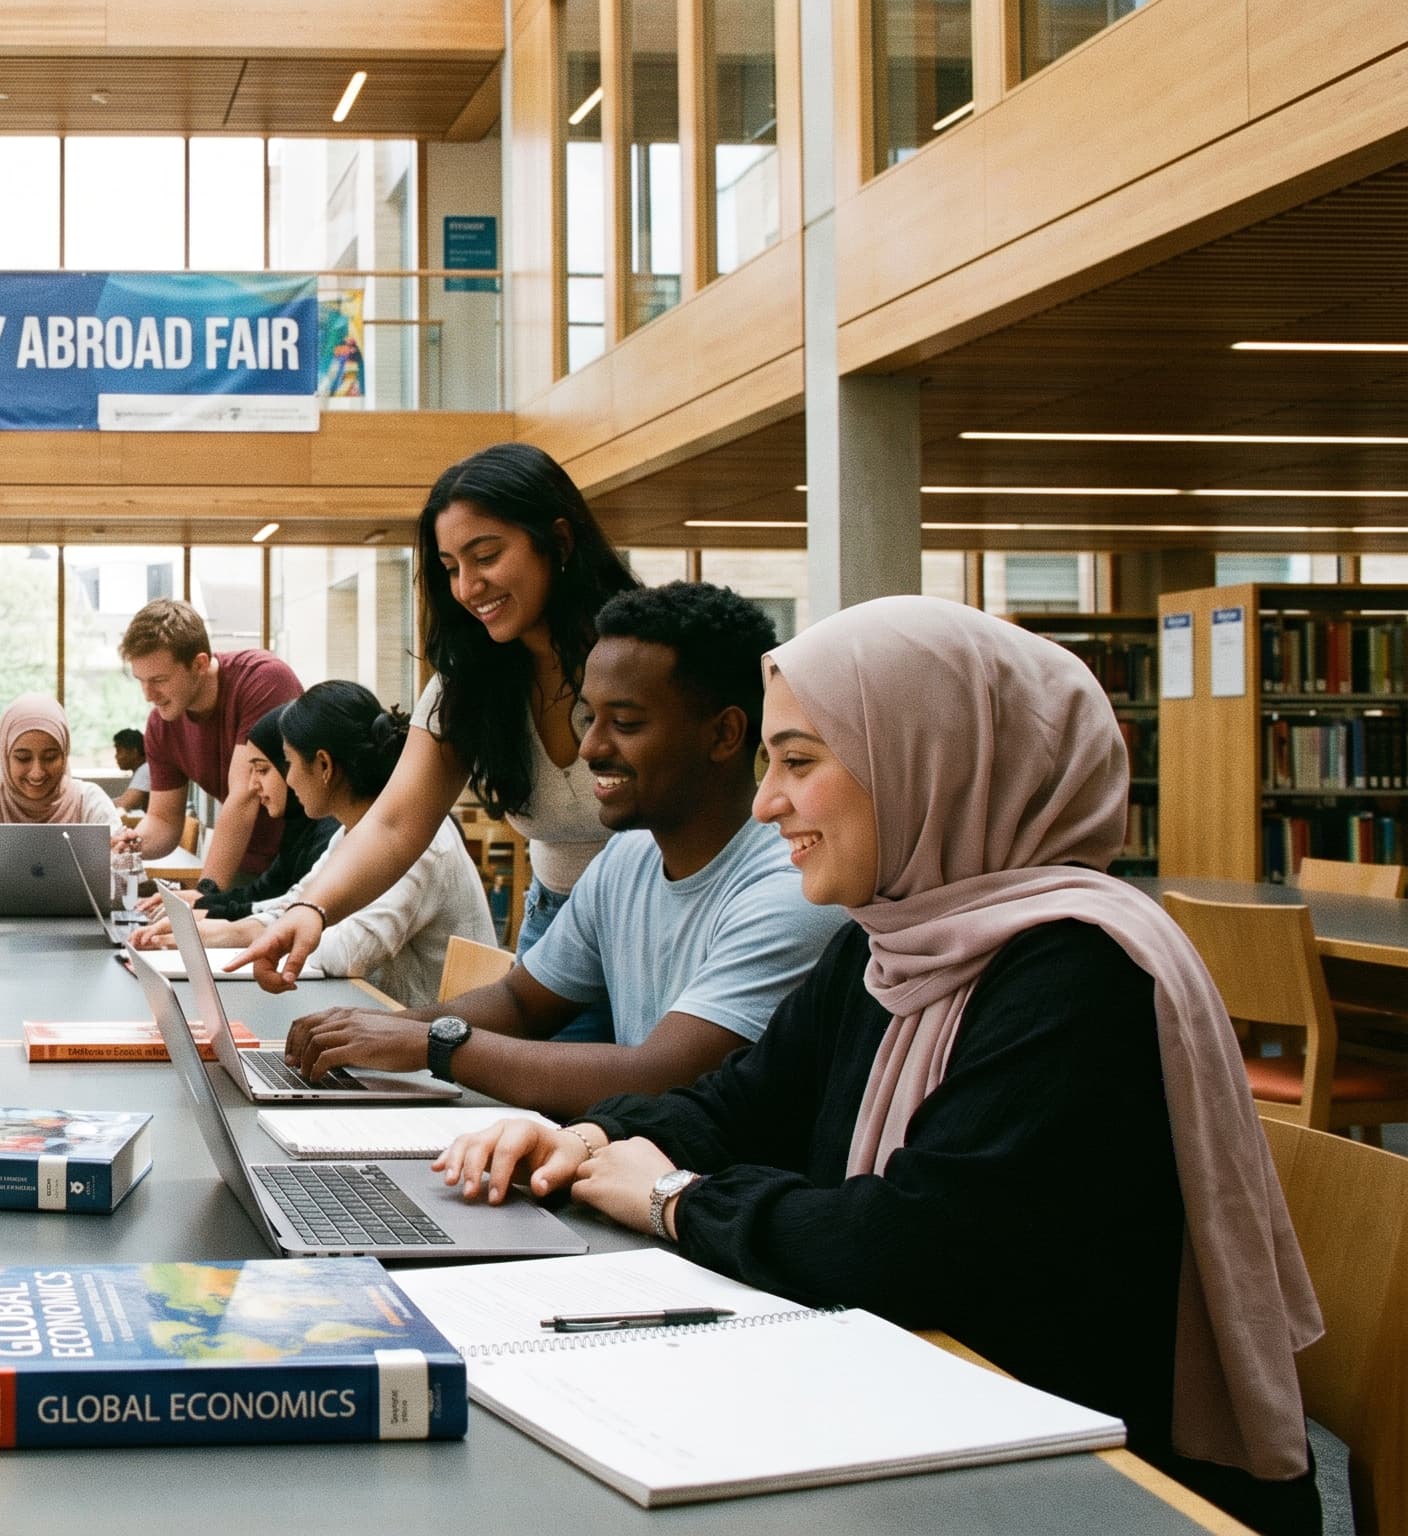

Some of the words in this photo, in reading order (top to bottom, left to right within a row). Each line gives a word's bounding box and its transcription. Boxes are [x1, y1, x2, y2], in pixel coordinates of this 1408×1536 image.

[16, 315, 194, 370] ABROAD
[205, 316, 300, 371] FAIR
[34, 1271, 94, 1357] ECONOMICS
[37, 1394, 161, 1424] GLOBAL
[170, 1388, 357, 1421] ECONOMICS
